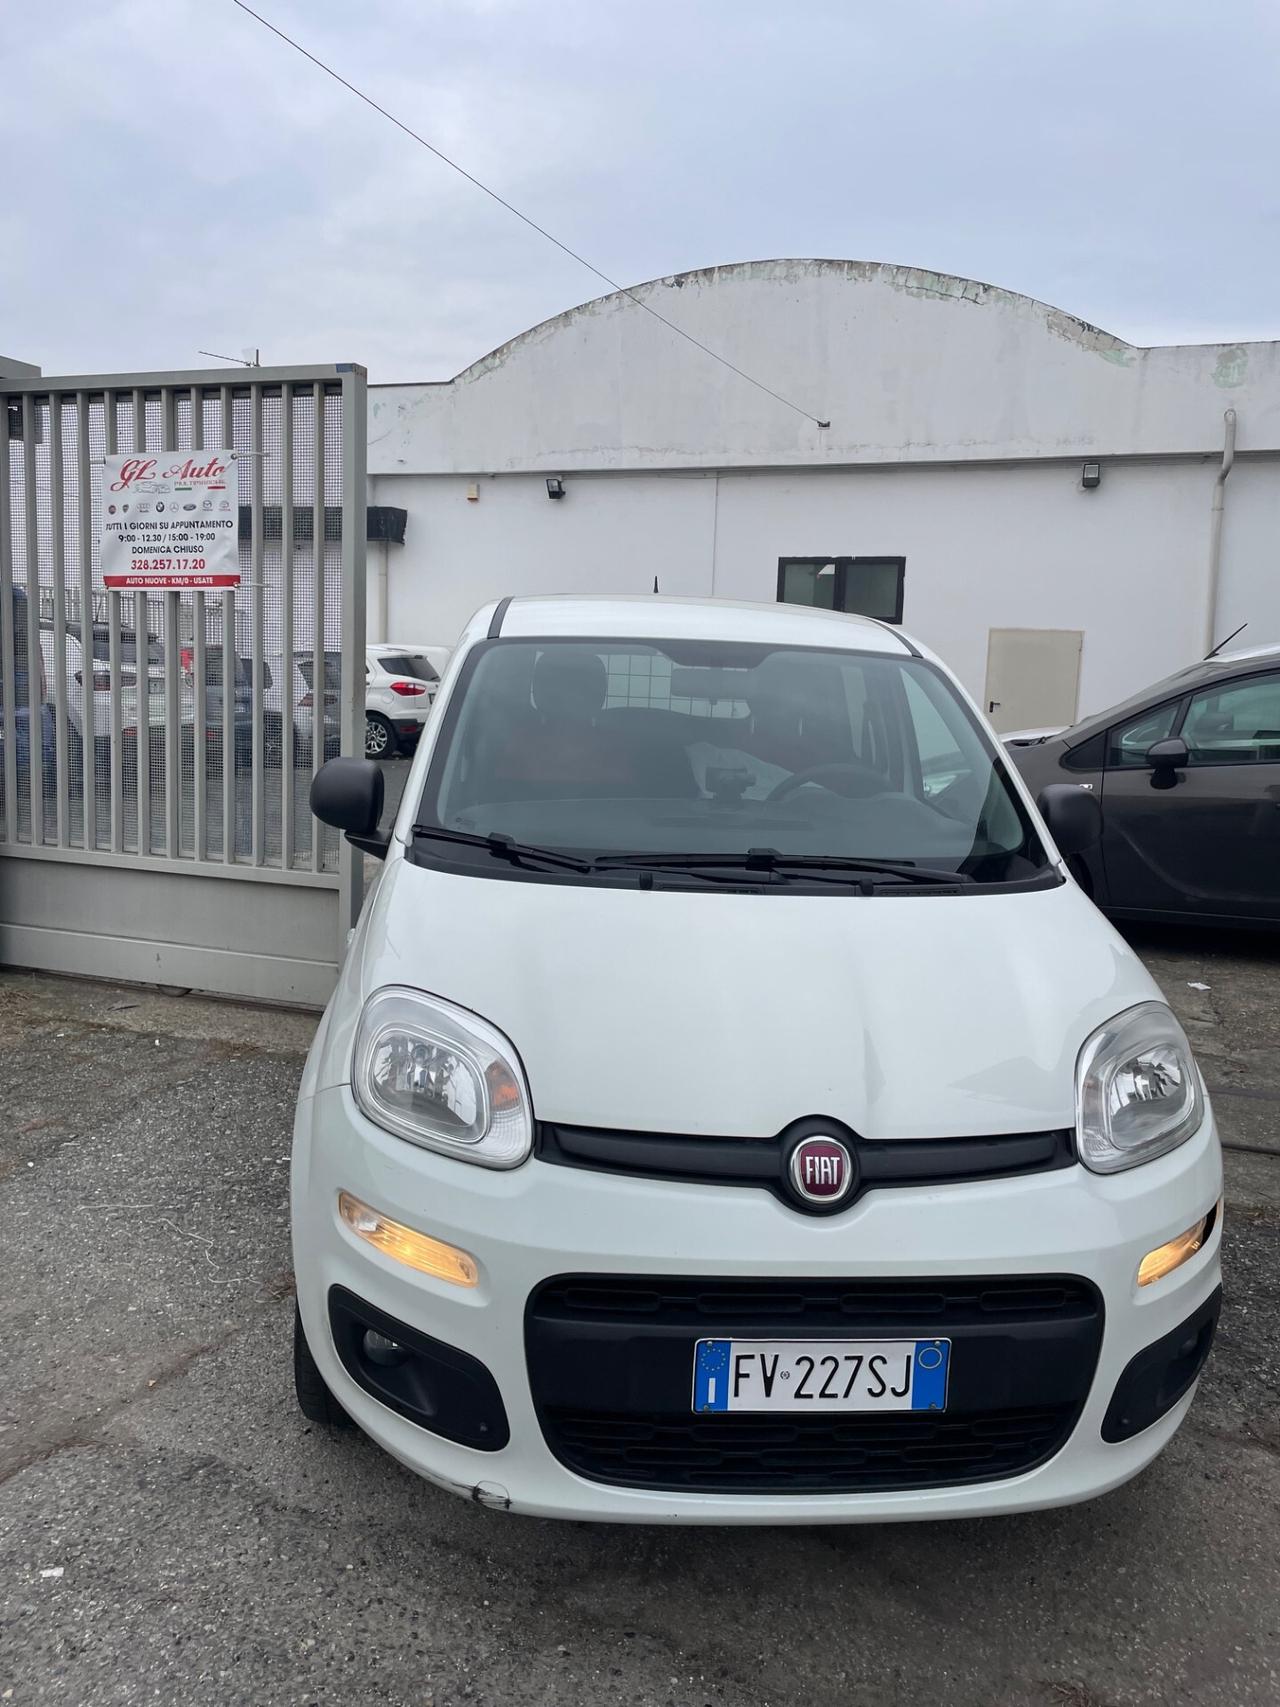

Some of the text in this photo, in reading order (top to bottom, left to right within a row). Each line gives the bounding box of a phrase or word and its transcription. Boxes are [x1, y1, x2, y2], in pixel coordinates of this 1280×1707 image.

[110, 457, 226, 491] GL Auto
[129, 521, 157, 530] GIORNI
[159, 521, 169, 529] SU
[170, 520, 234, 529] APPUNTAMENTO
[118, 534, 136, 542] 9:00
[141, 533, 162, 542] 12.30
[168, 533, 189, 541] 15:00
[195, 532, 216, 541] 19:00
[131, 545, 204, 554] DOMENICA CHIUSO
[130, 559, 206, 570] 328.257.17.20
[125, 577, 144, 585] AUTO
[193, 576, 213, 584] USATE
[805, 1156, 841, 1185] FIAT
[733, 1353, 912, 1399] FV 227SJ
[707, 1377, 716, 1404] I
